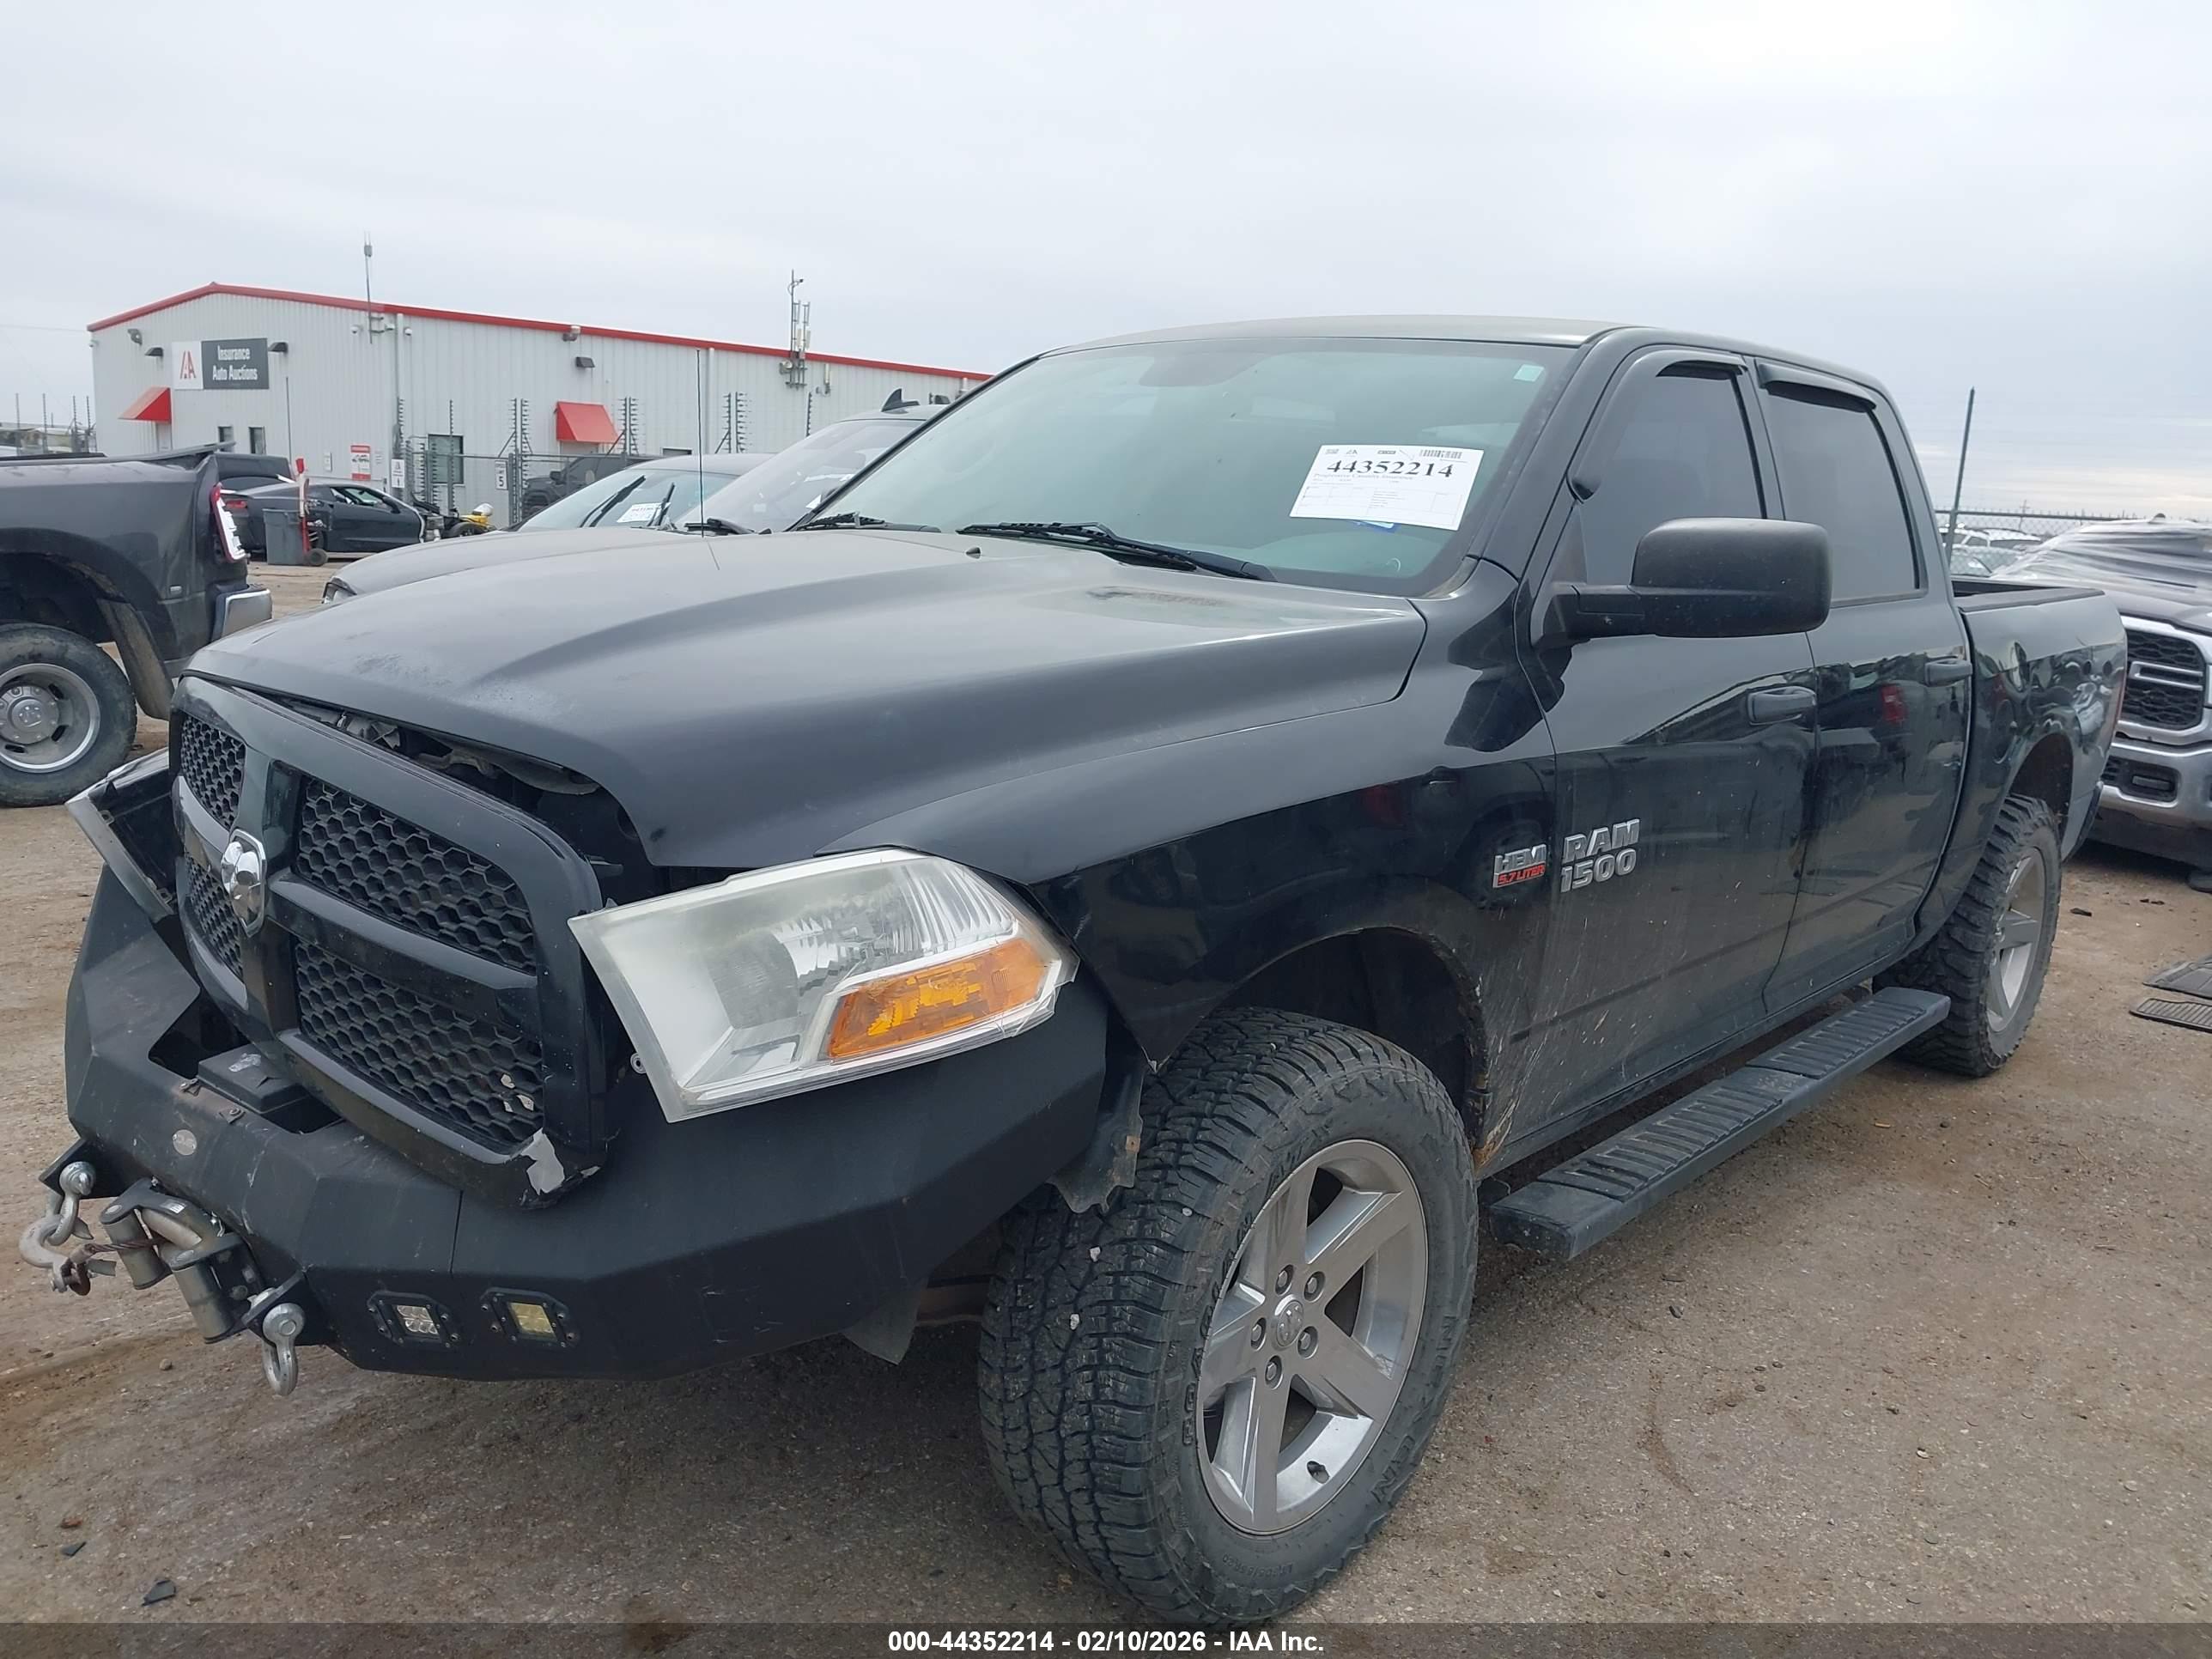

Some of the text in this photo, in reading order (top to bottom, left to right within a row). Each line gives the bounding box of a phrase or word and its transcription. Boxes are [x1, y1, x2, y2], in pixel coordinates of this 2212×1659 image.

[217, 345, 251, 361] Insurance
[212, 364, 258, 380] Auto Auctions
[1327, 459, 1454, 478] 44352214
[1562, 818, 1640, 864] RAM
[1494, 844, 1547, 874] HEMI
[1498, 865, 1546, 884] 5.7 LITER
[1559, 848, 1637, 893] 1500
